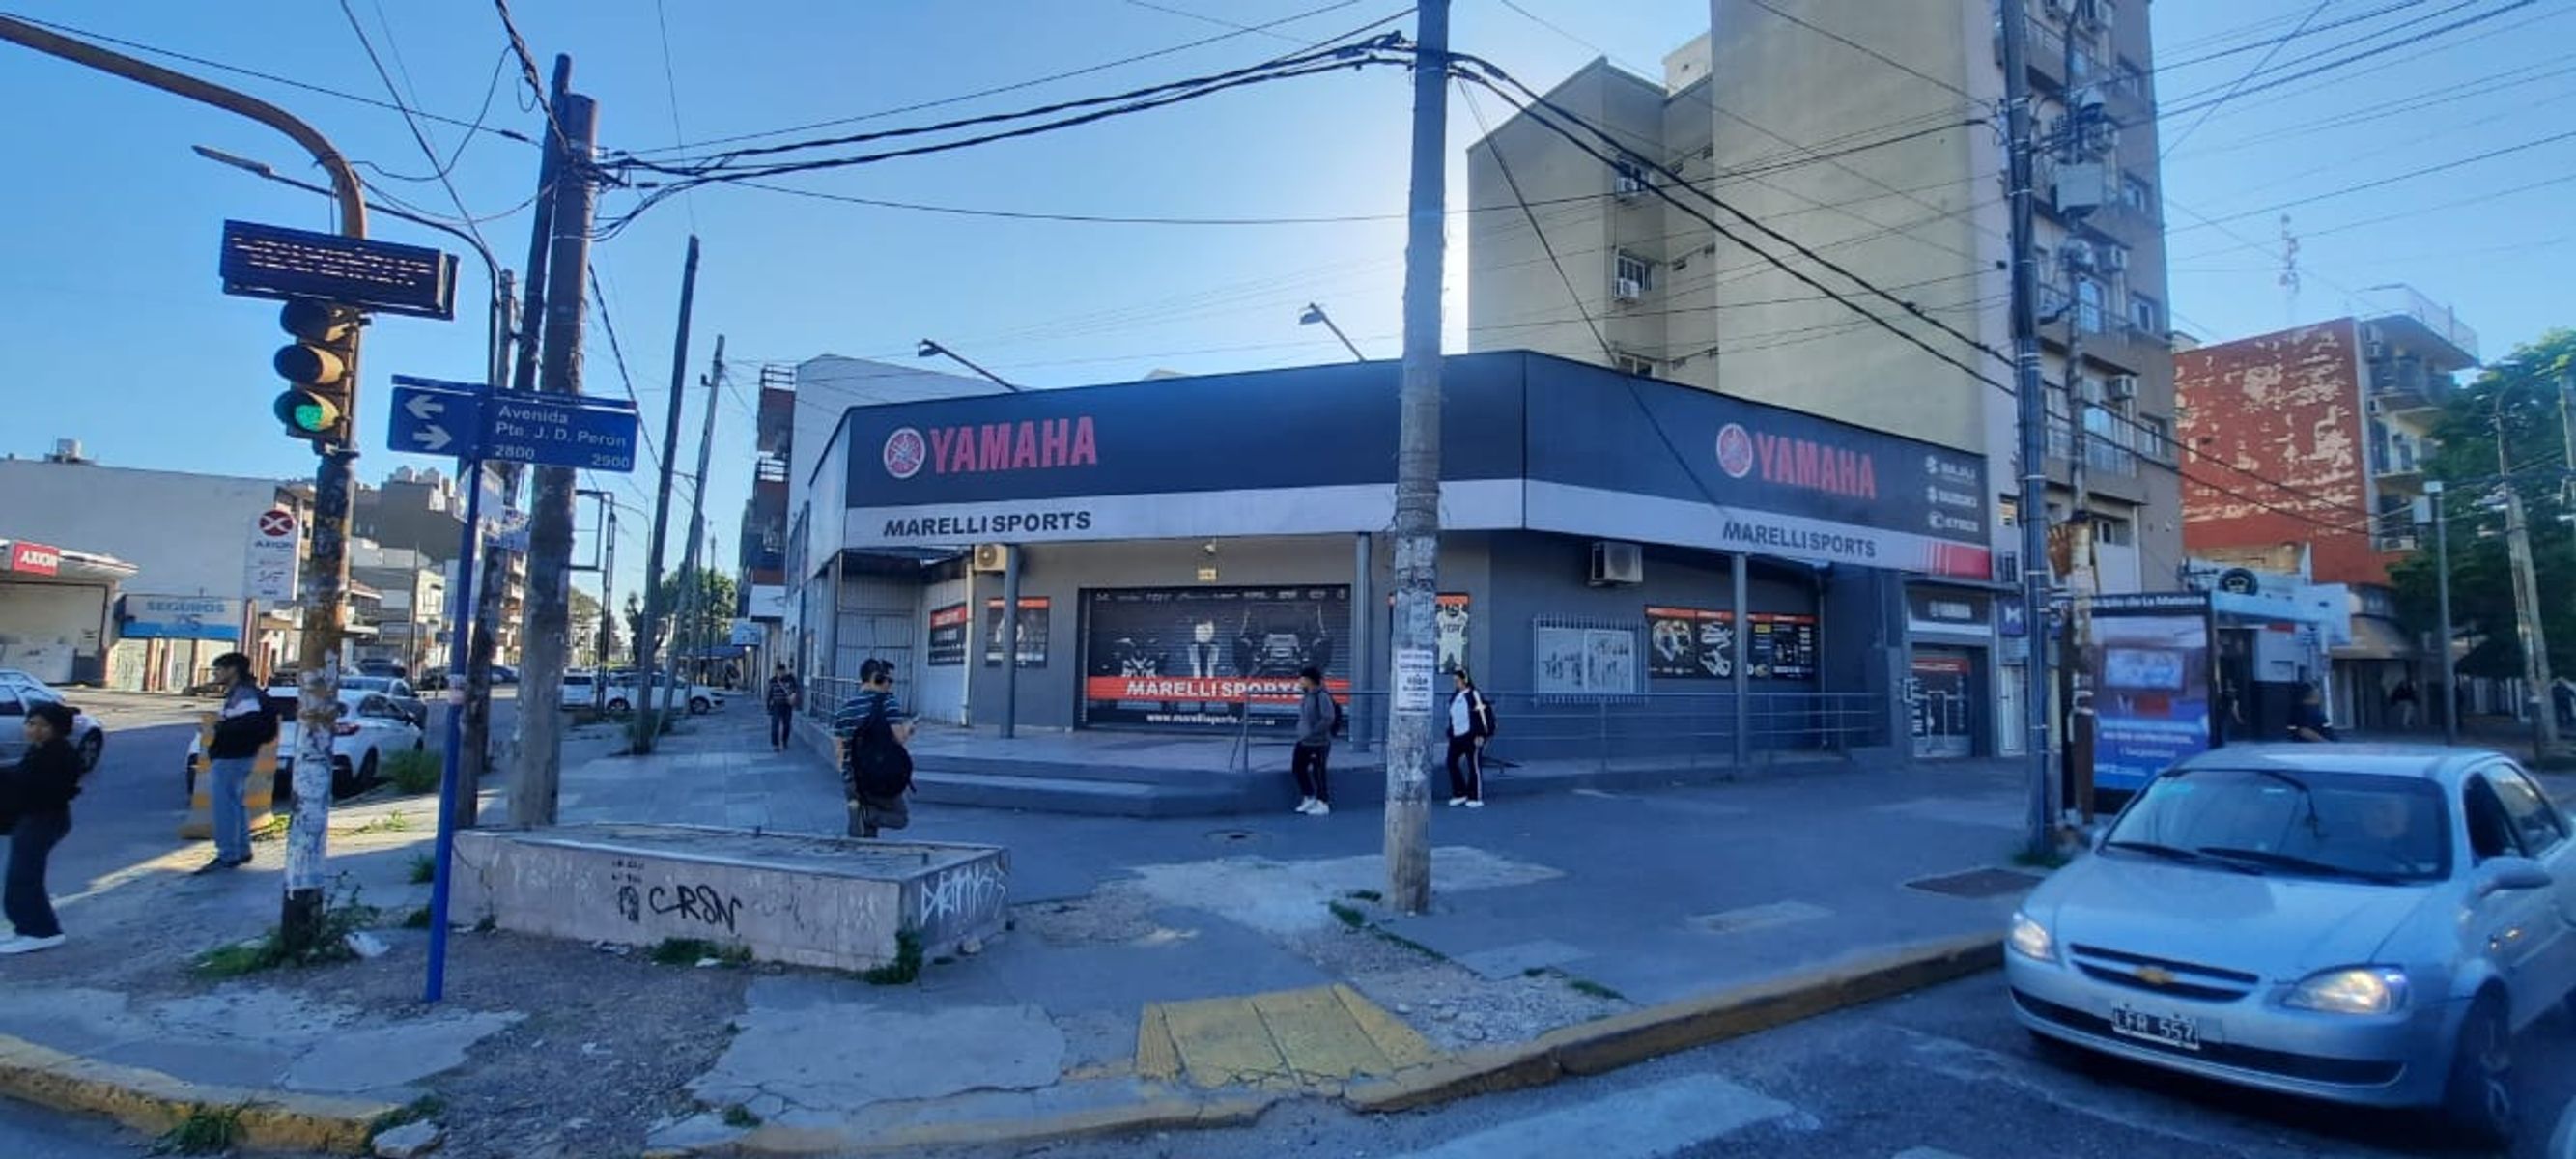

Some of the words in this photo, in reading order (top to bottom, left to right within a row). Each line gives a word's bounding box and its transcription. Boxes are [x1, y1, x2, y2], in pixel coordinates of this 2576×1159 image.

[498, 405, 568, 425] Avenida
[495, 444, 535, 460] 2800
[929, 416, 1097, 474] YAMAHA
[592, 453, 630, 468] 2900
[1756, 432, 1876, 499] YAMAHA
[20, 550, 58, 568] AXION
[146, 600, 226, 613] SEGUROS
[1126, 679, 1216, 697] MARELLI
[2159, 1020, 2193, 1041] 557
